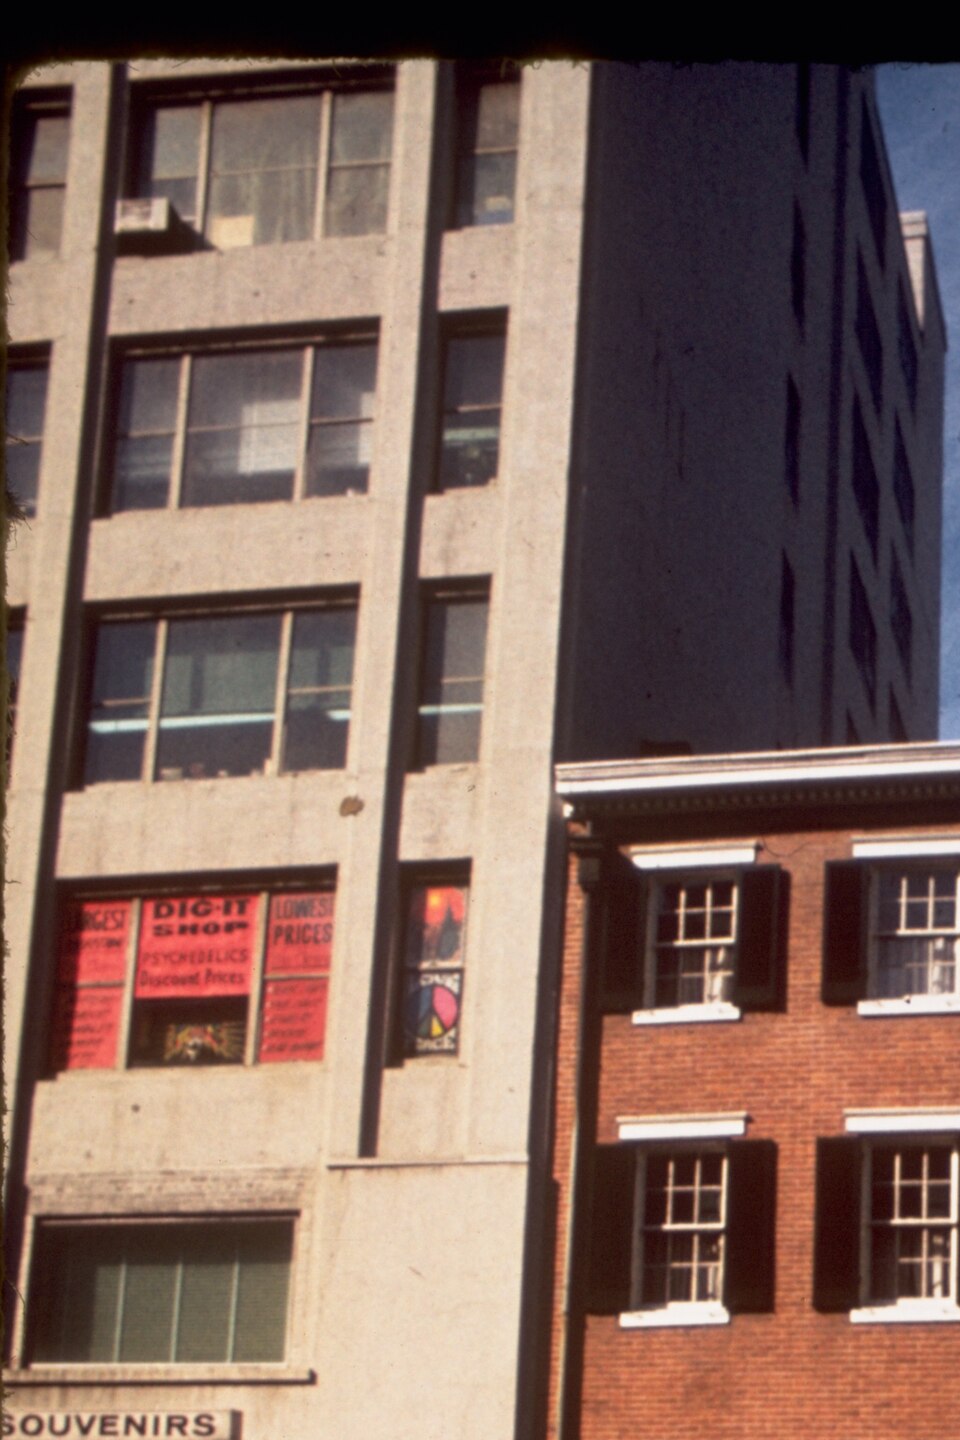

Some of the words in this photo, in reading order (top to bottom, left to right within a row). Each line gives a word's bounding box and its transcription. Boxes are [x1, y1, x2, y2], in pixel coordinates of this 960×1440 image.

[153, 921, 249, 937] SHOP
[273, 923, 333, 946] PRICES
[1, 1413, 216, 1437] SOUVENIRS
